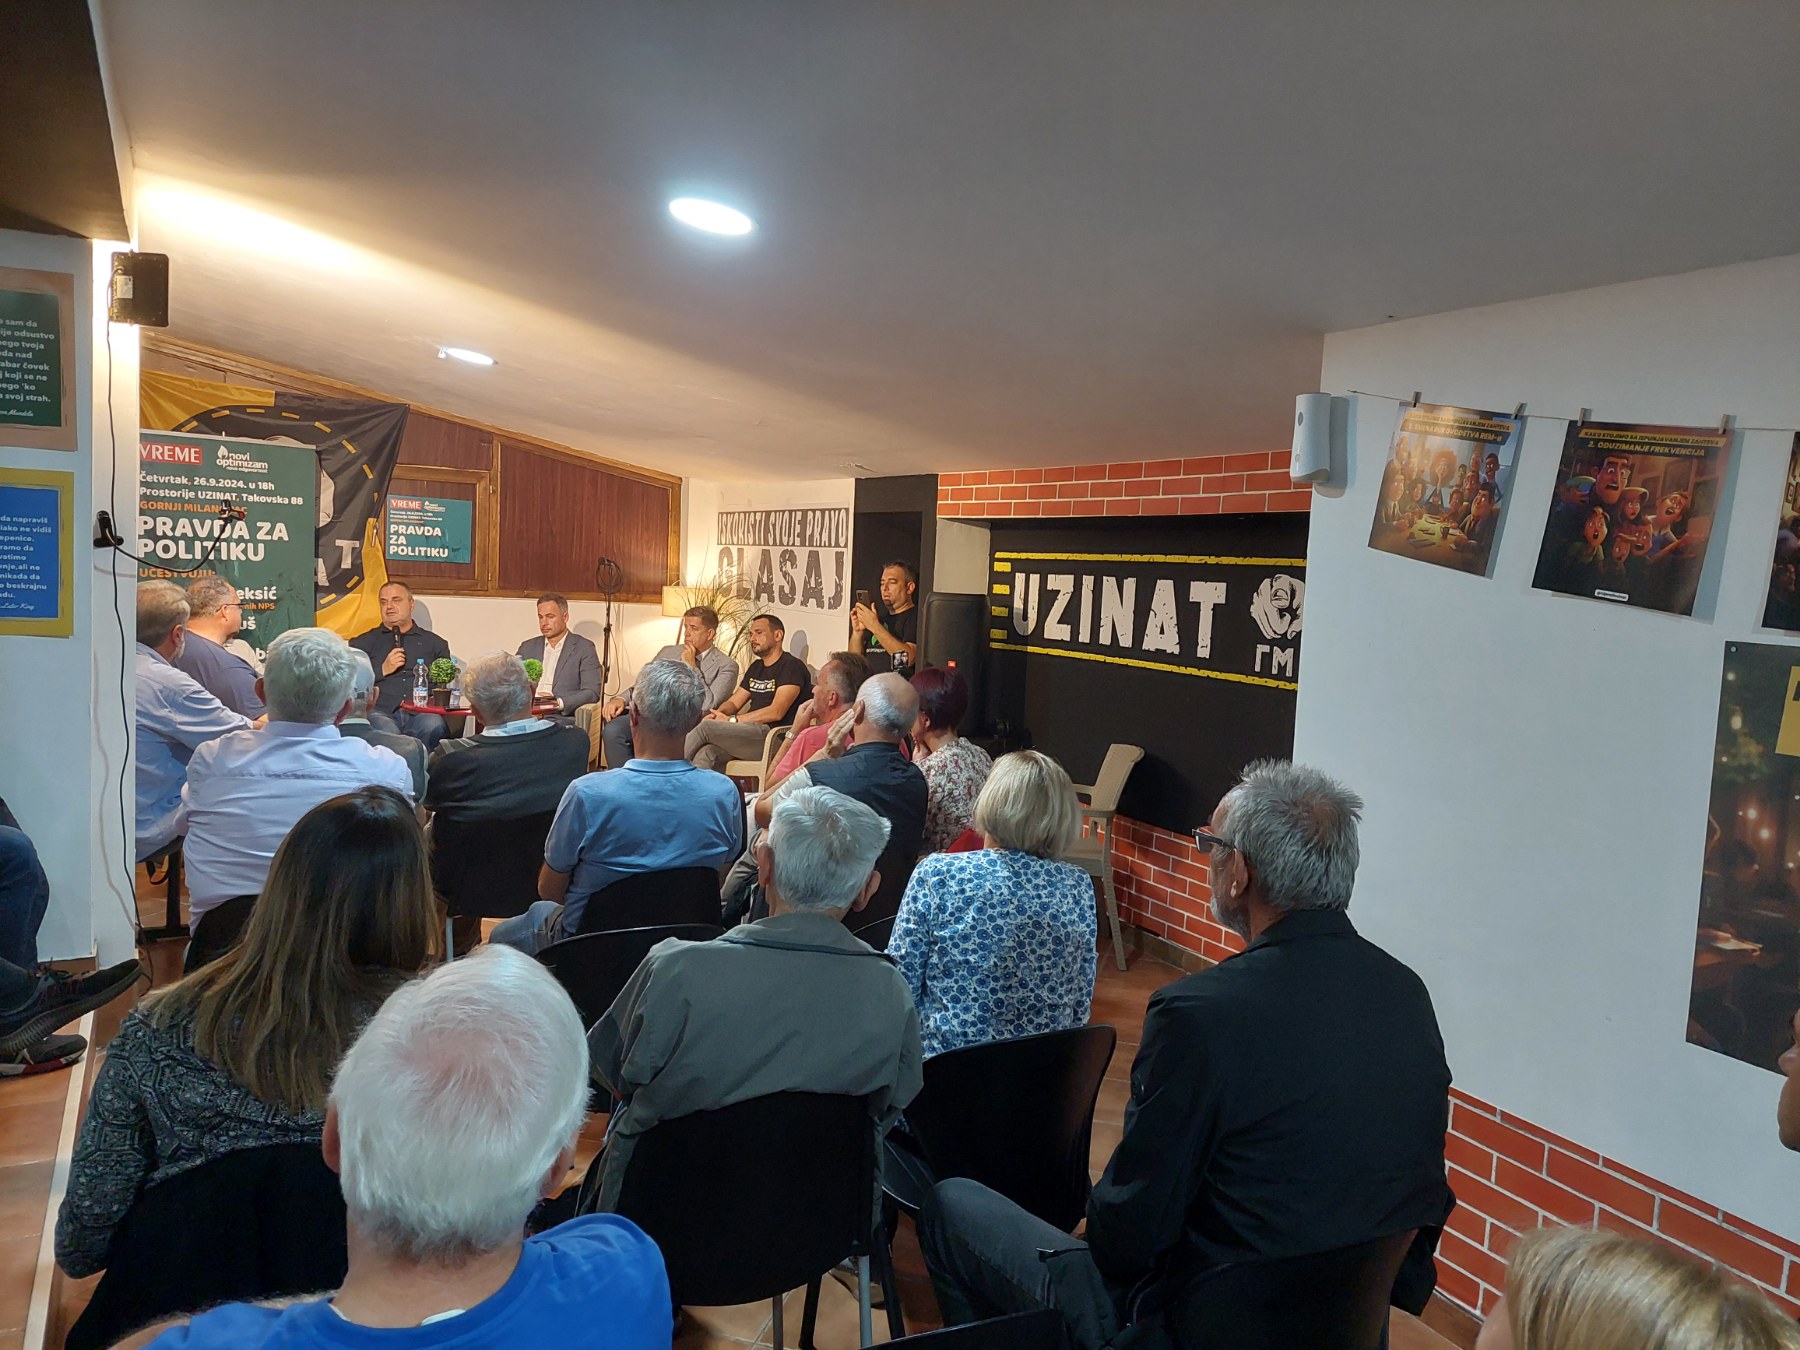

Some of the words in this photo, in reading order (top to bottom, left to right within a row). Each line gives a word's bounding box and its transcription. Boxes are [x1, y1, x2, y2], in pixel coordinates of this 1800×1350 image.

[14, 330, 55, 339] odsustvo
[21, 342, 45, 350] tvoja
[22, 362, 50, 371] čovek
[5, 370, 22, 380] koji
[5, 393, 24, 402] svoj
[139, 444, 201, 464] VREME
[1597, 441, 1650, 452] ODUZIMANJE
[1650, 446, 1705, 457] FREKVENCIJA
[228, 452, 250, 461] novi
[216, 458, 268, 468] optimizam
[139, 471, 192, 486] Četvrtak,
[193, 477, 247, 489] 26.9.2024.
[248, 481, 256, 489] u
[257, 482, 275, 491] 18h
[139, 487, 196, 500] Prostorije
[241, 493, 290, 504] Takovska
[290, 497, 304, 505] 88
[139, 501, 182, 511] GORNJI
[391, 500, 422, 510] VREME
[137, 515, 250, 540] PRAVDA
[256, 521, 290, 542] ZA
[390, 524, 442, 537] PRAVDA
[718, 511, 766, 546] ISKORISTI
[768, 511, 802, 546] SVOJE
[805, 508, 847, 547] PRAVO
[389, 535, 407, 545] ZA
[137, 539, 265, 562] POLITIKU
[389, 546, 449, 558] POLITIKU
[6, 582, 47, 591] beskrajnu
[258, 602, 276, 610] NPS
[1013, 571, 1227, 659] UZINAT
